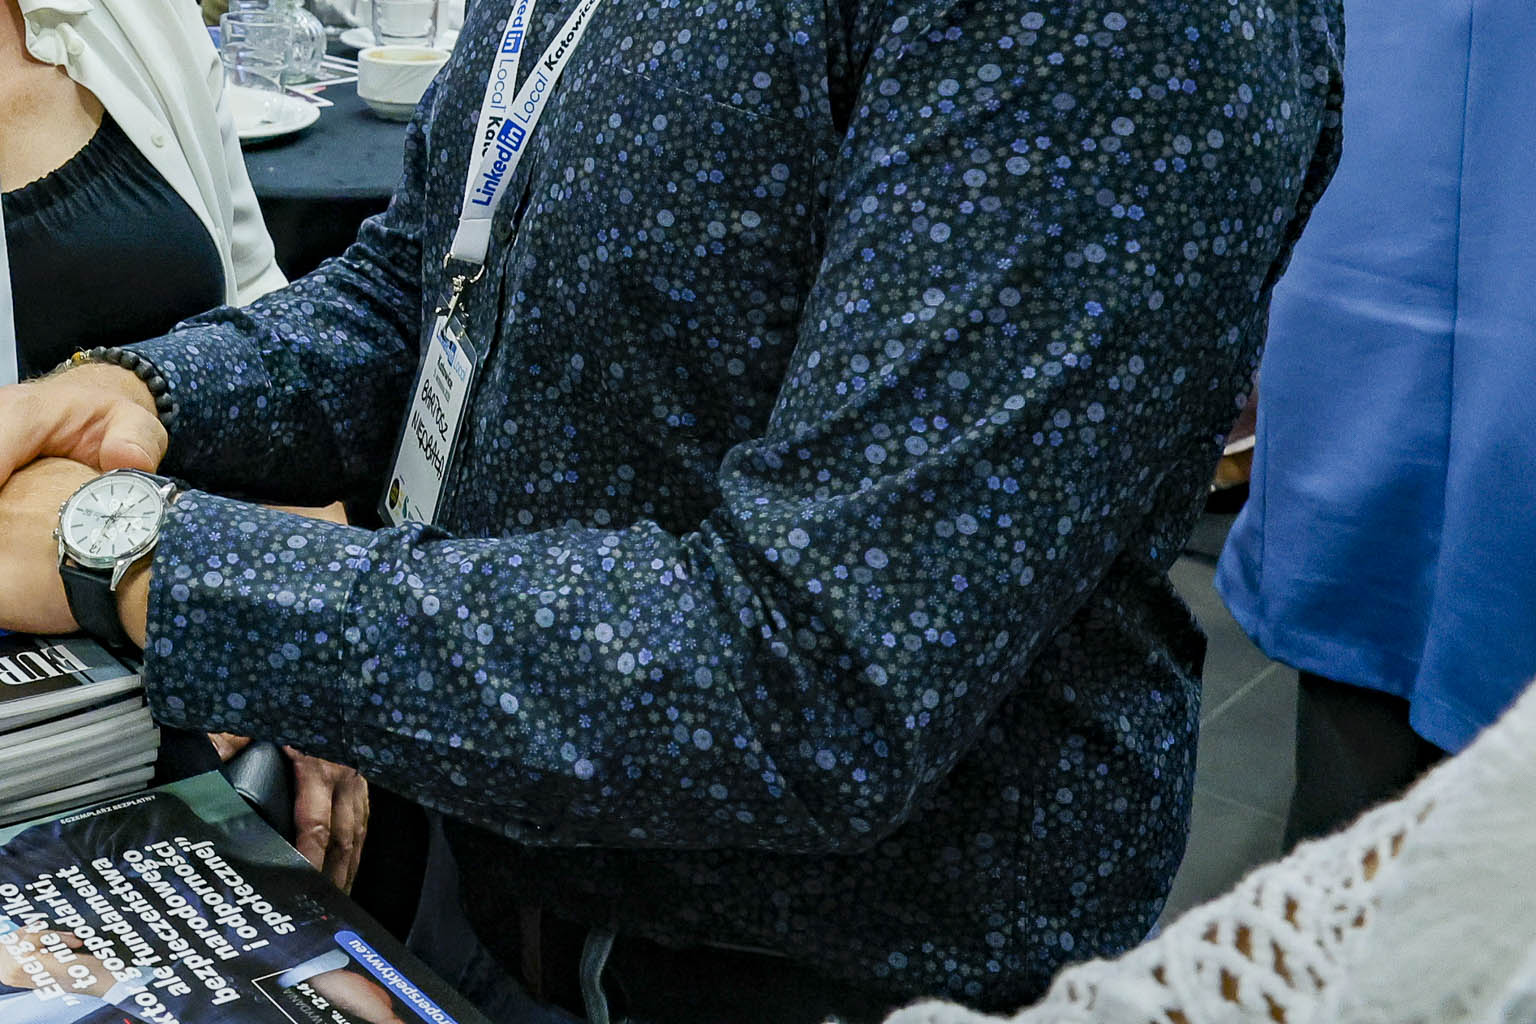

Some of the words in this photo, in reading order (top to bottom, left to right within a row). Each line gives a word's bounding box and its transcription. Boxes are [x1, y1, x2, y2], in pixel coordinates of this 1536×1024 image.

[25, 873, 142, 983] gospodarki,
[56, 865, 162, 968] fundament
[91, 857, 241, 1005] bezpieczeństwa
[123, 849, 240, 961] narodowego
[144, 840, 258, 940] odporności
[40, 932, 78, 964] nie
[67, 965, 98, 990] to
[153, 965, 192, 997] ale
[242, 939, 270, 952] i
[349, 939, 455, 1024] roperspektywy.eu
[125, 985, 180, 1024] ktor
